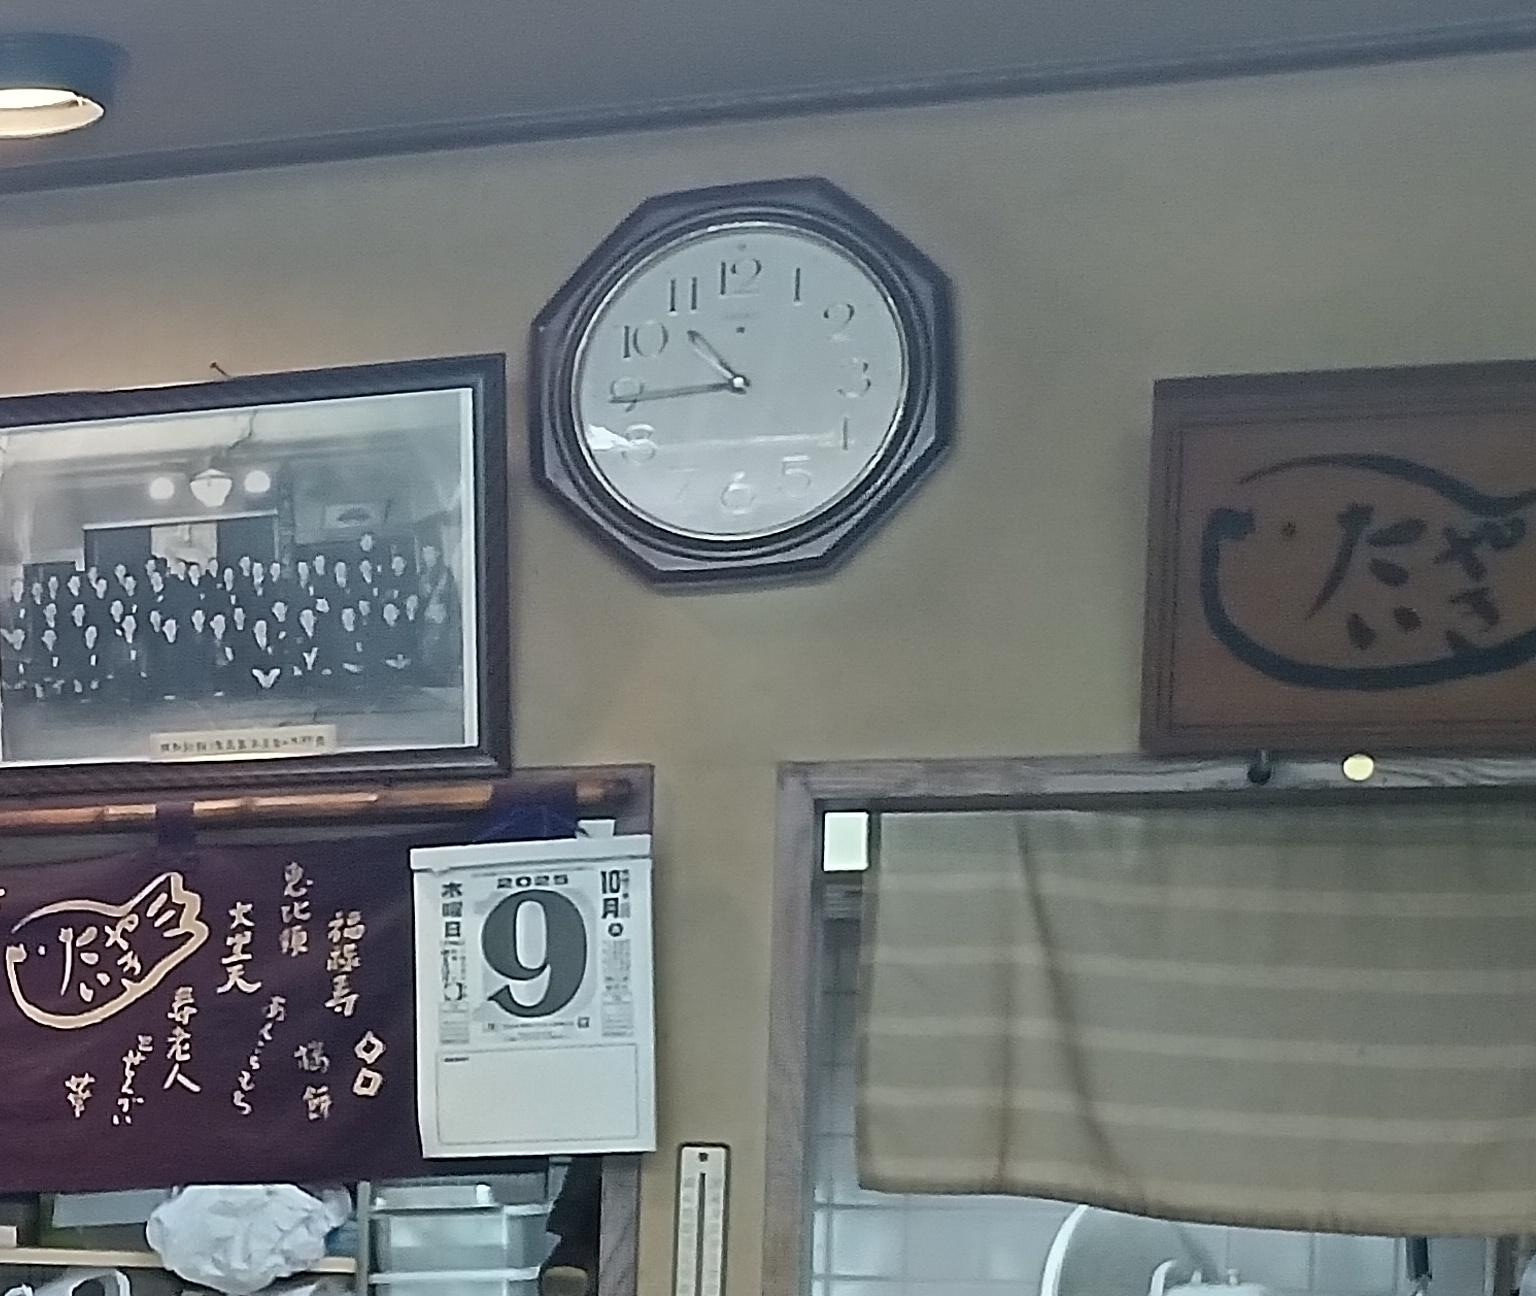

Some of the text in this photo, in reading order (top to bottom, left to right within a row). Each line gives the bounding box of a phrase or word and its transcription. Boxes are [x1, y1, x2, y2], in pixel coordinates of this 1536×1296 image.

[668, 276, 698, 315] 11
[718, 257, 763, 298] 12
[792, 267, 802, 302] 1
[620, 320, 669, 359] 10
[823, 302, 855, 341] 2
[837, 356, 873, 399] 3
[721, 471, 756, 515] 6
[496, 874, 570, 890] 2025
[440, 881, 464, 938] 木曜日
[58, 912, 143, 1003] たいやき
[481, 887, 589, 1019] 9
